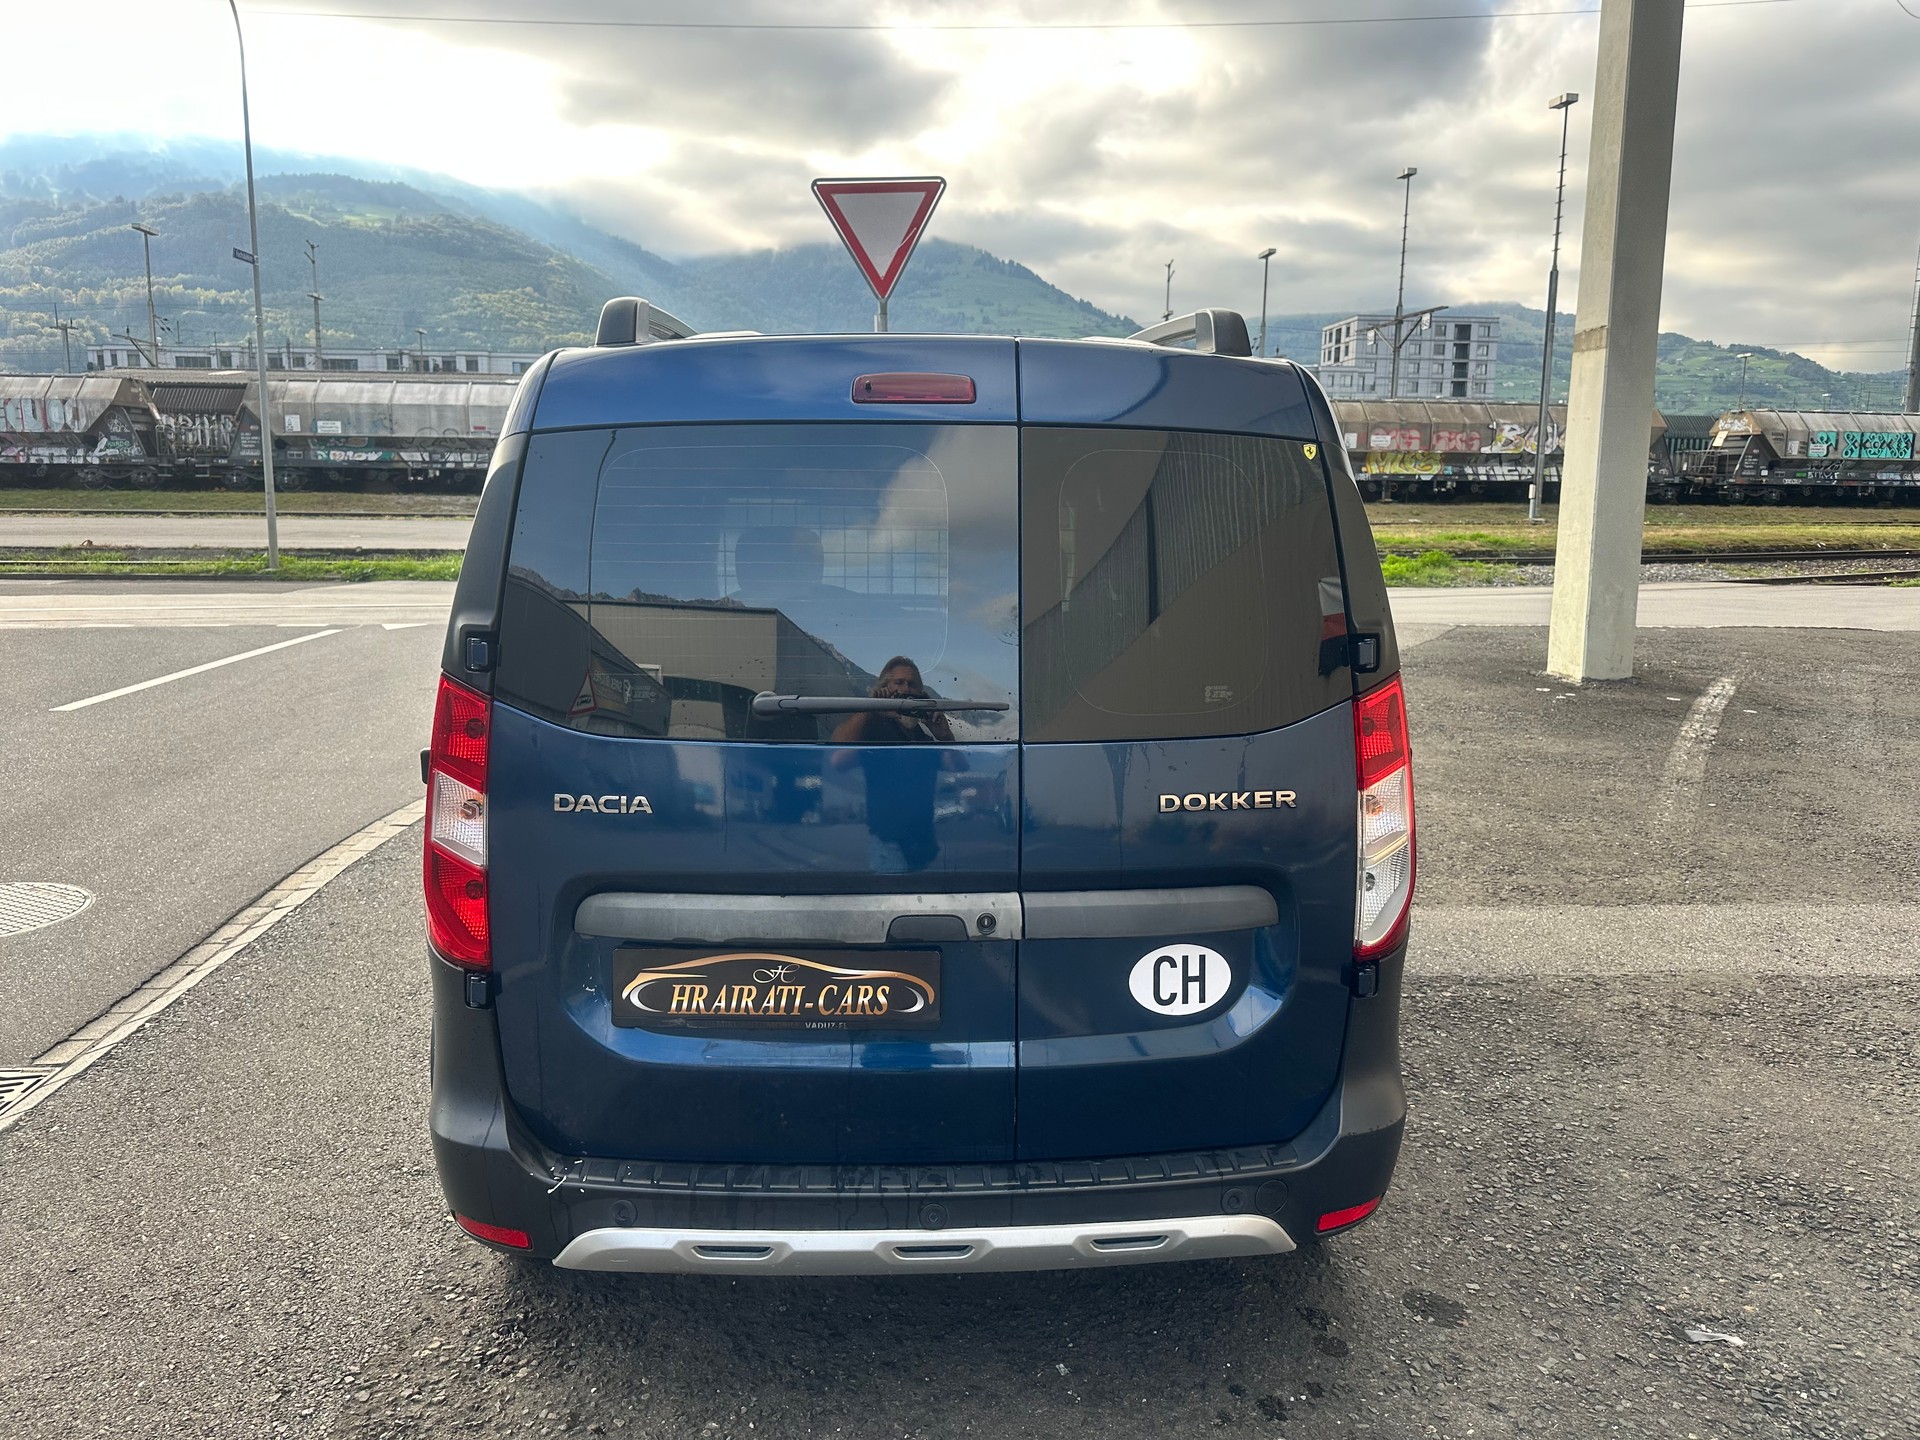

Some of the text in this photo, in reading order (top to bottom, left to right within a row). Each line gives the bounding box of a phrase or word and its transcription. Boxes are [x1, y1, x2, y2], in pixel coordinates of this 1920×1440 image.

[553, 793, 653, 814] DACIA
[1159, 790, 1297, 813] DOKKER
[1153, 954, 1206, 1006] CH
[667, 984, 890, 1016] HRAIRATI-CARS
